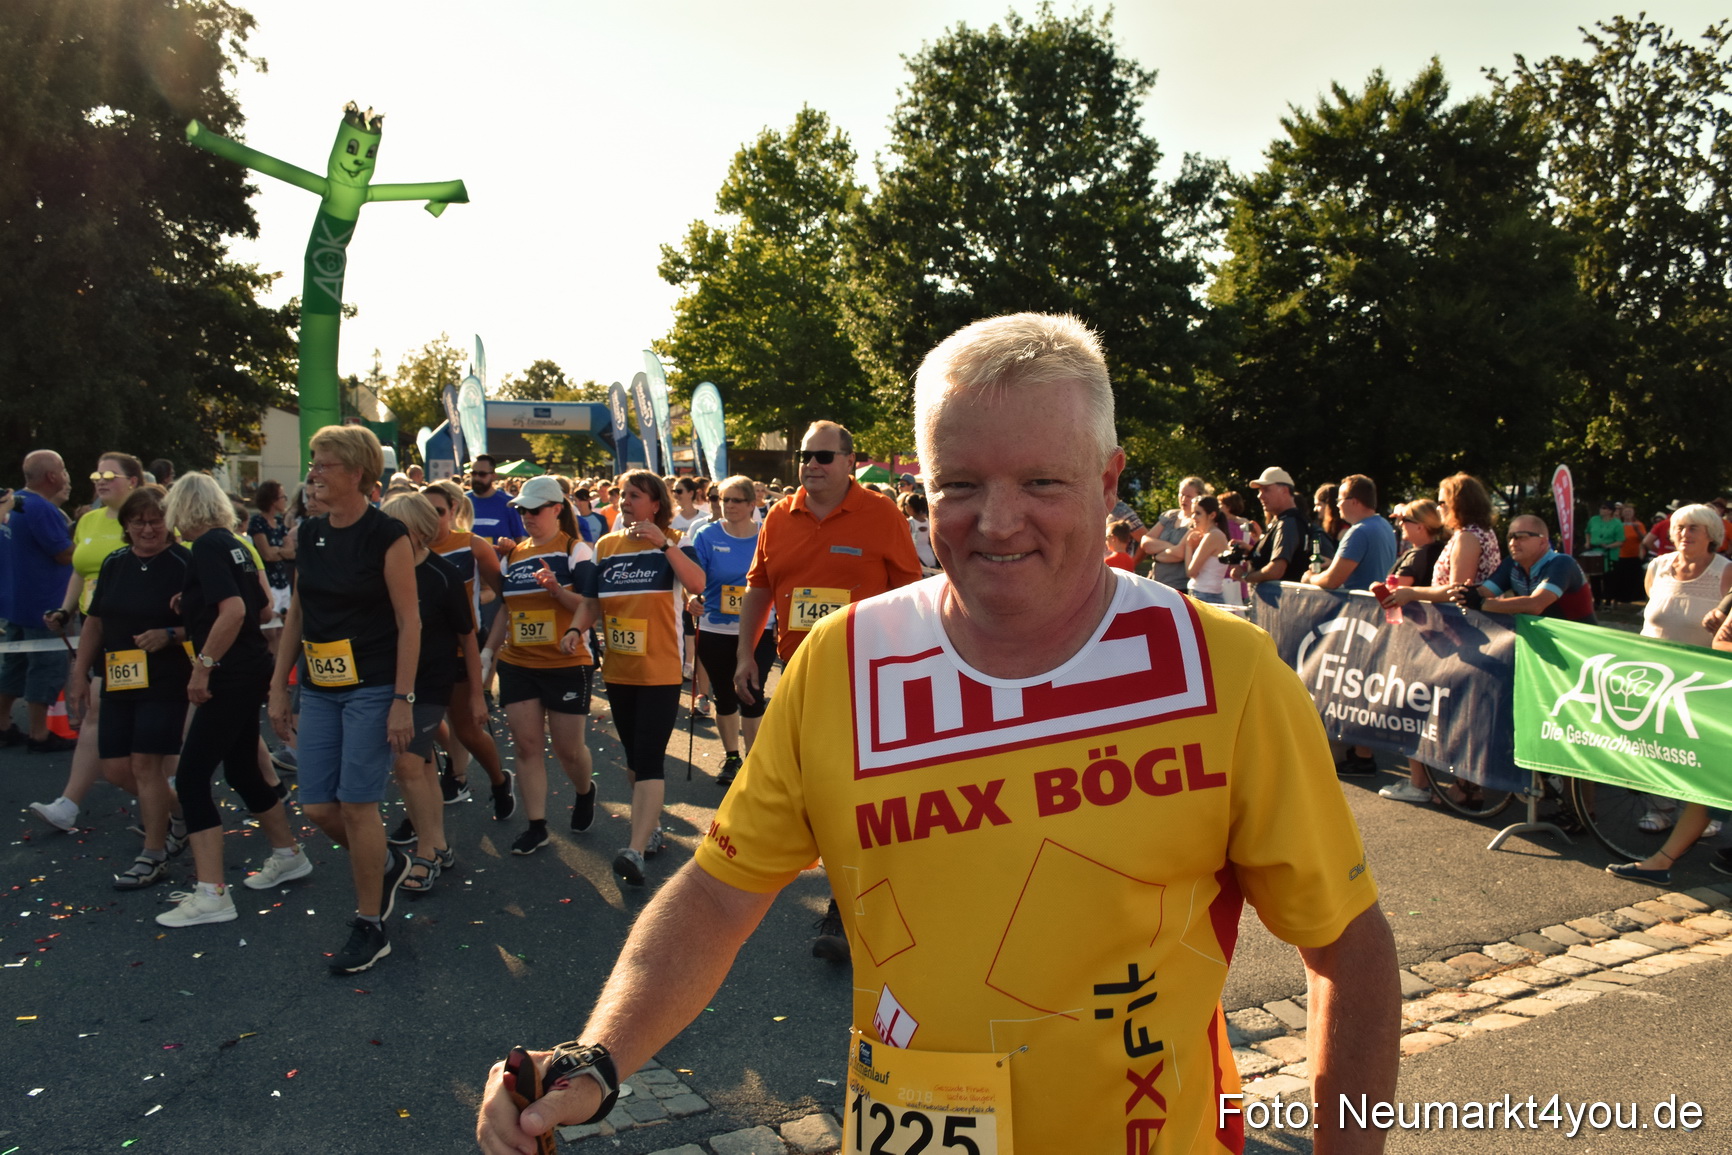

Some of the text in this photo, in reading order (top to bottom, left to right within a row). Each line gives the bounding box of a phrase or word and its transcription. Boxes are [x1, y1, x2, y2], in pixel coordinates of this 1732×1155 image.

[313, 218, 356, 304] AOK
[612, 569, 658, 580] Fischer
[521, 622, 544, 637] 597
[612, 629, 636, 645] 613
[109, 663, 139, 680] 1661
[310, 657, 347, 675] 1643
[1316, 653, 1451, 717] Fischer
[1550, 653, 1732, 740] AOK
[1325, 702, 1439, 742] AUTOMOBILE
[1541, 721, 1702, 768] Die Gesundheitskasse.
[855, 742, 1228, 850] MAX BÖGL
[898, 1087, 933, 1104] 2018
[852, 1094, 981, 1155] 1225
